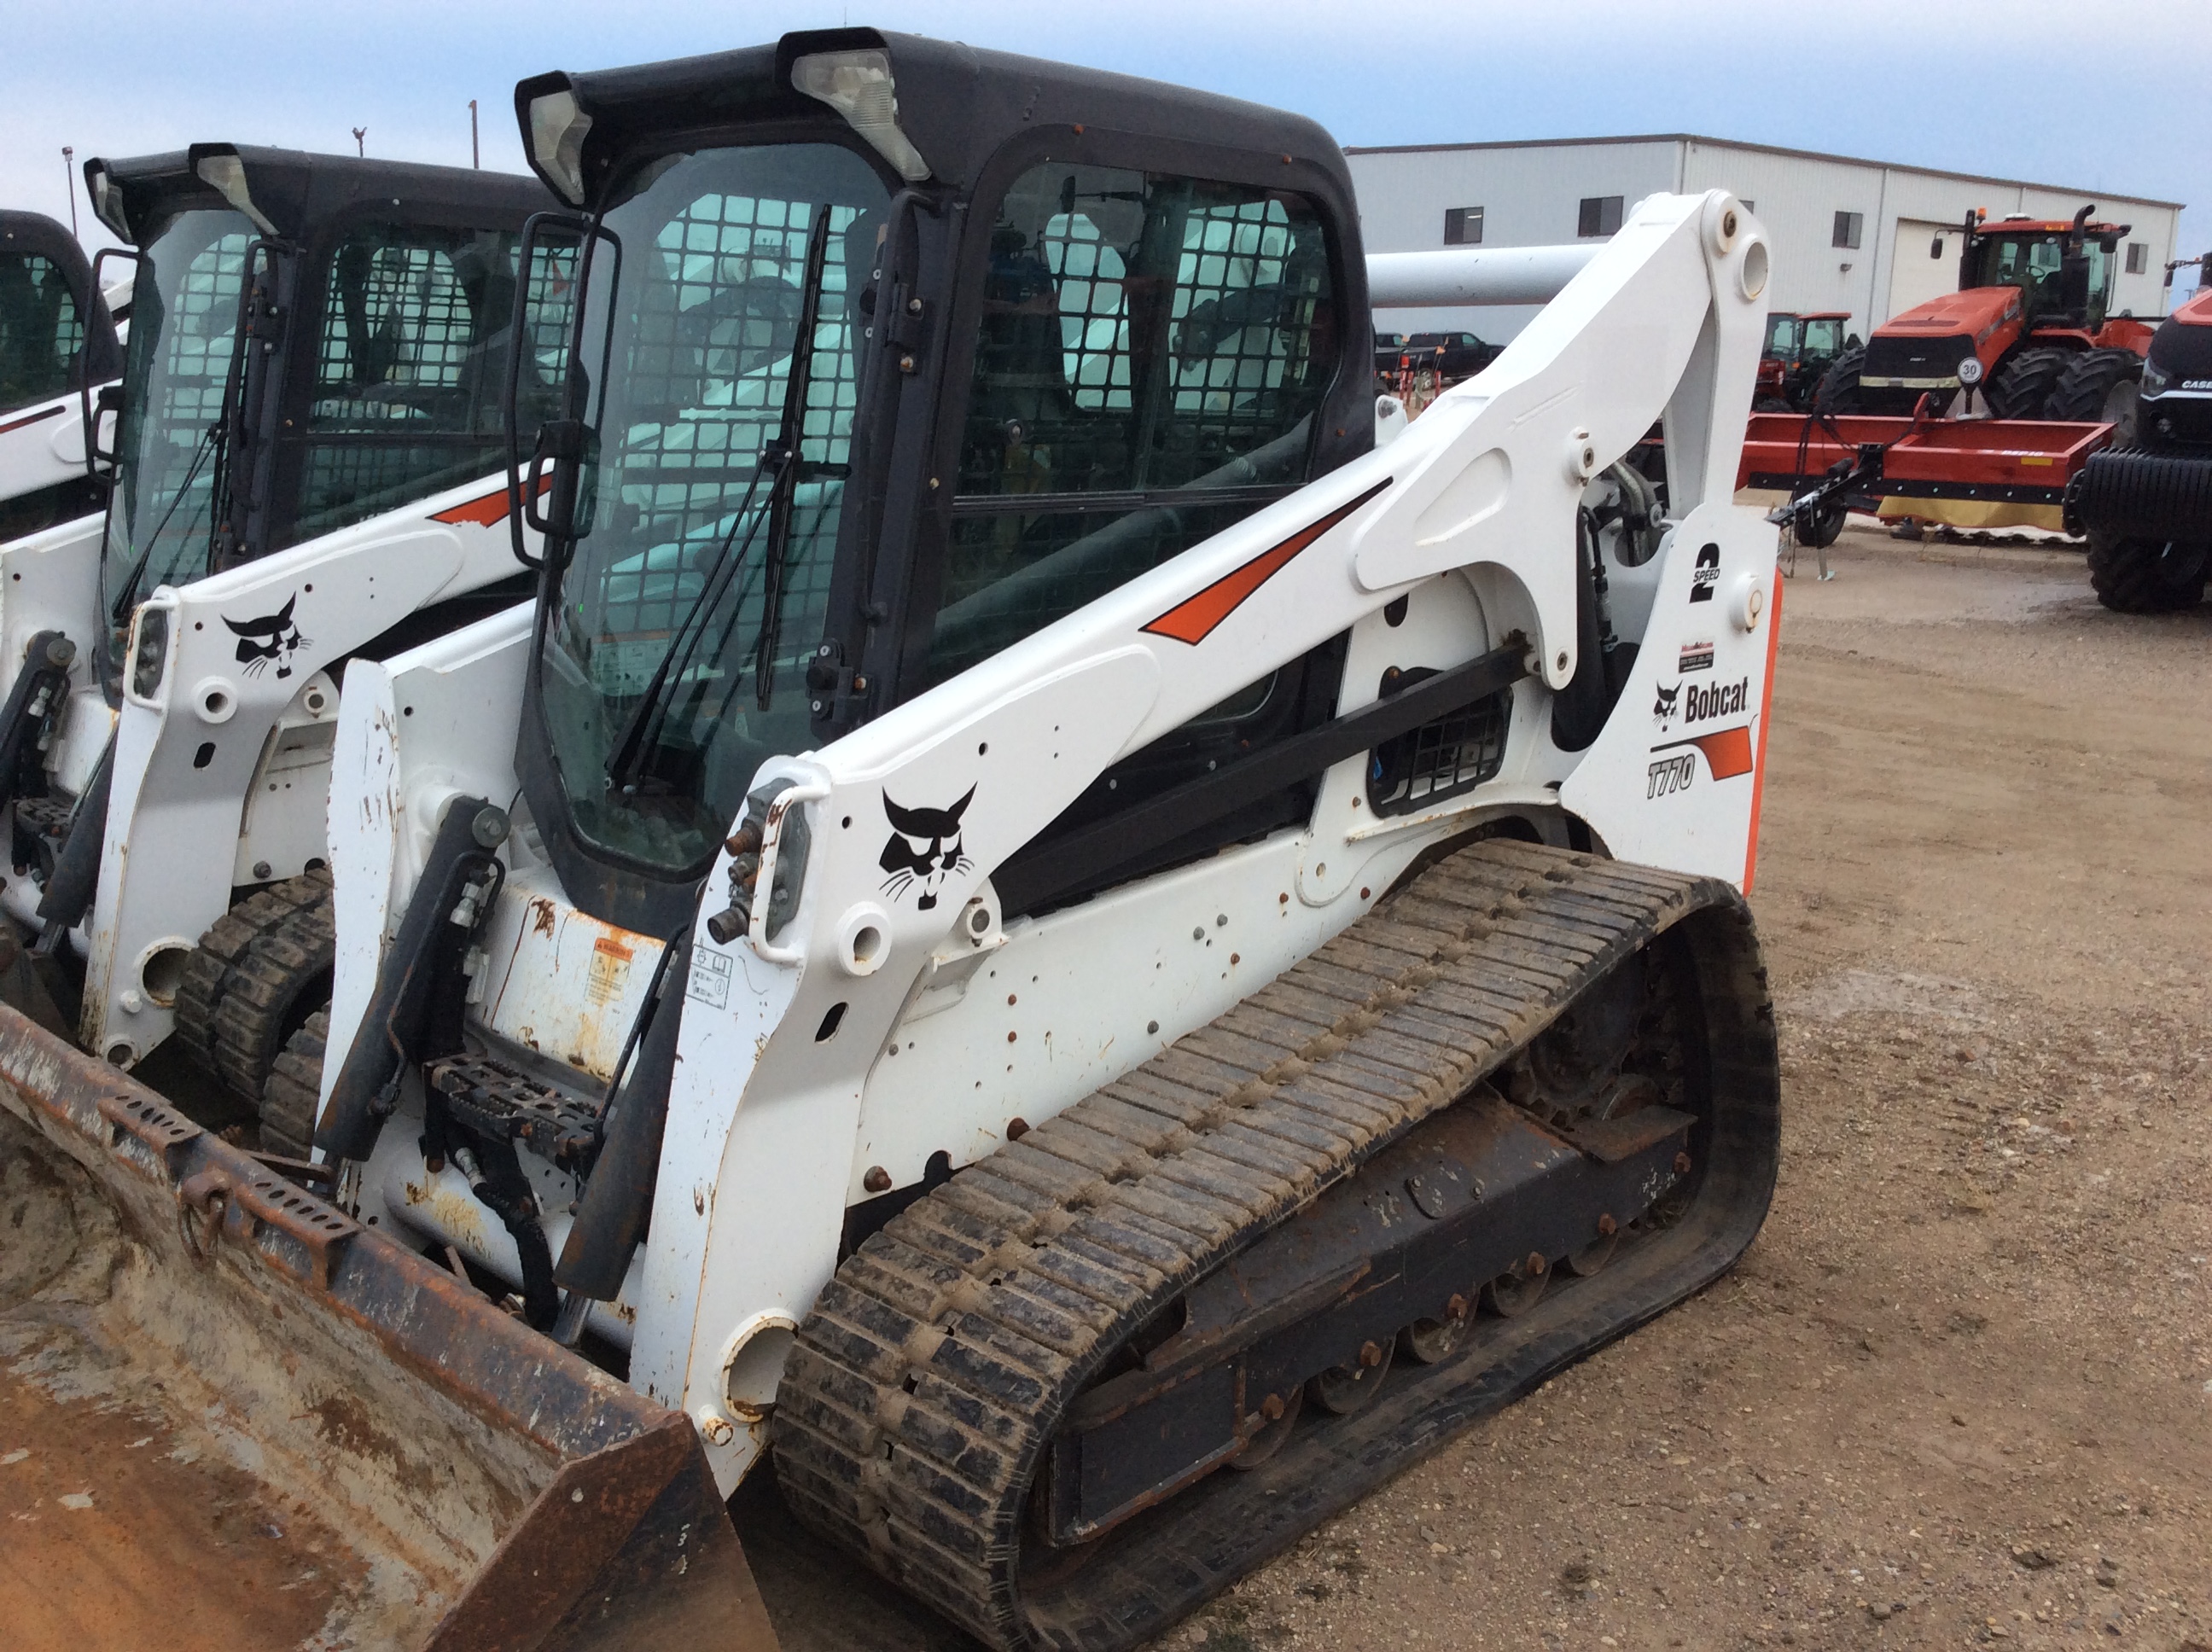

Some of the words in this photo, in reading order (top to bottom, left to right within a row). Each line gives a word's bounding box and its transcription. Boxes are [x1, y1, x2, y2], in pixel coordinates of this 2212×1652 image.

[1963, 364, 1977, 375] 30
[2181, 380, 2212, 389] CASE
[1689, 542, 1720, 604] 2
[1692, 568, 1720, 583] SPEED
[1685, 676, 1749, 724] Bobcat
[1647, 753, 1696, 800] T770
